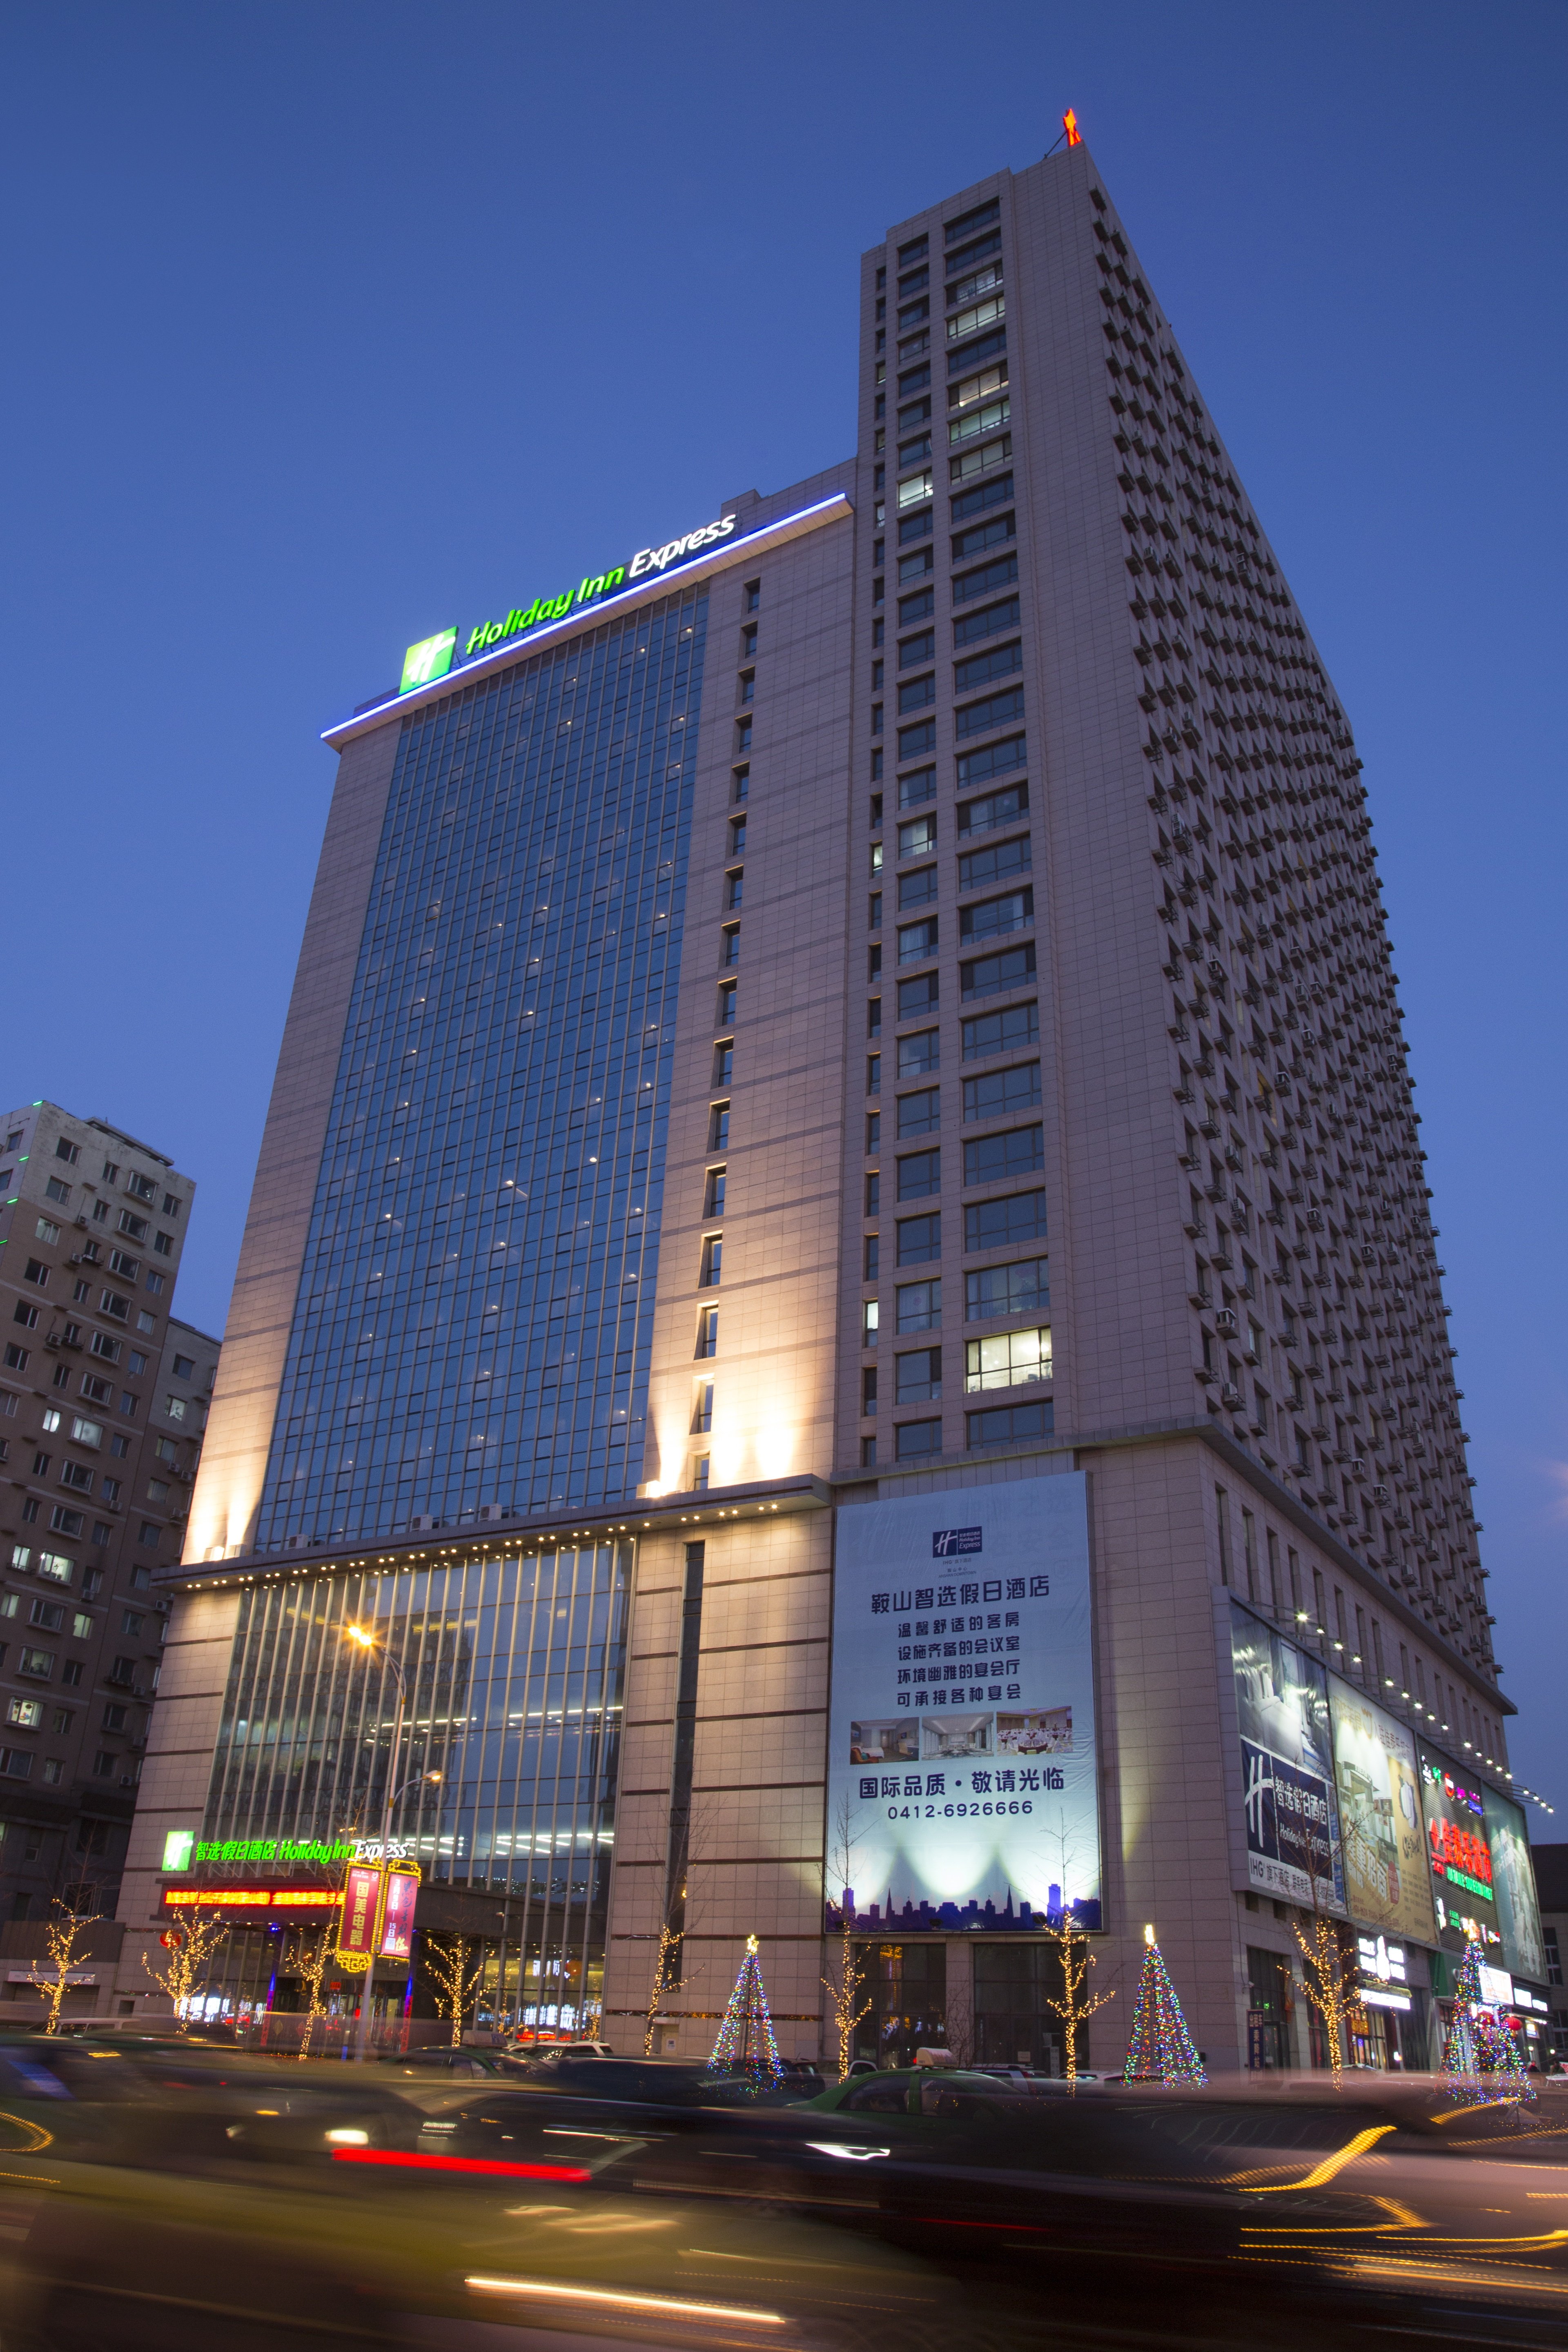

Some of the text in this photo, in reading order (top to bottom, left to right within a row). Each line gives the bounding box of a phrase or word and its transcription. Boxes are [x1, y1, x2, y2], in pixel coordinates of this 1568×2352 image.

[466, 514, 736, 655] Holiday Inn Express
[959, 1541, 980, 1550] Express
[871, 1575, 1050, 1614] 鞍山智选假日酒店
[898, 1612, 1020, 1638] 温馨舒适的客房
[898, 1636, 1020, 1661] 设施齐备的会议室
[898, 1659, 1020, 1684] 环境幽雅的宴会厅
[897, 1684, 1021, 1707] 可承接各种宴会
[888, 1800, 1033, 1820] 0412-6926666
[196, 1840, 278, 1861] 智选假日酒店
[279, 1839, 333, 1864] Holiday
[332, 1838, 356, 1860] Inn
[1250, 1857, 1263, 1878] IHG
[350, 1881, 370, 1946] 国美电器
